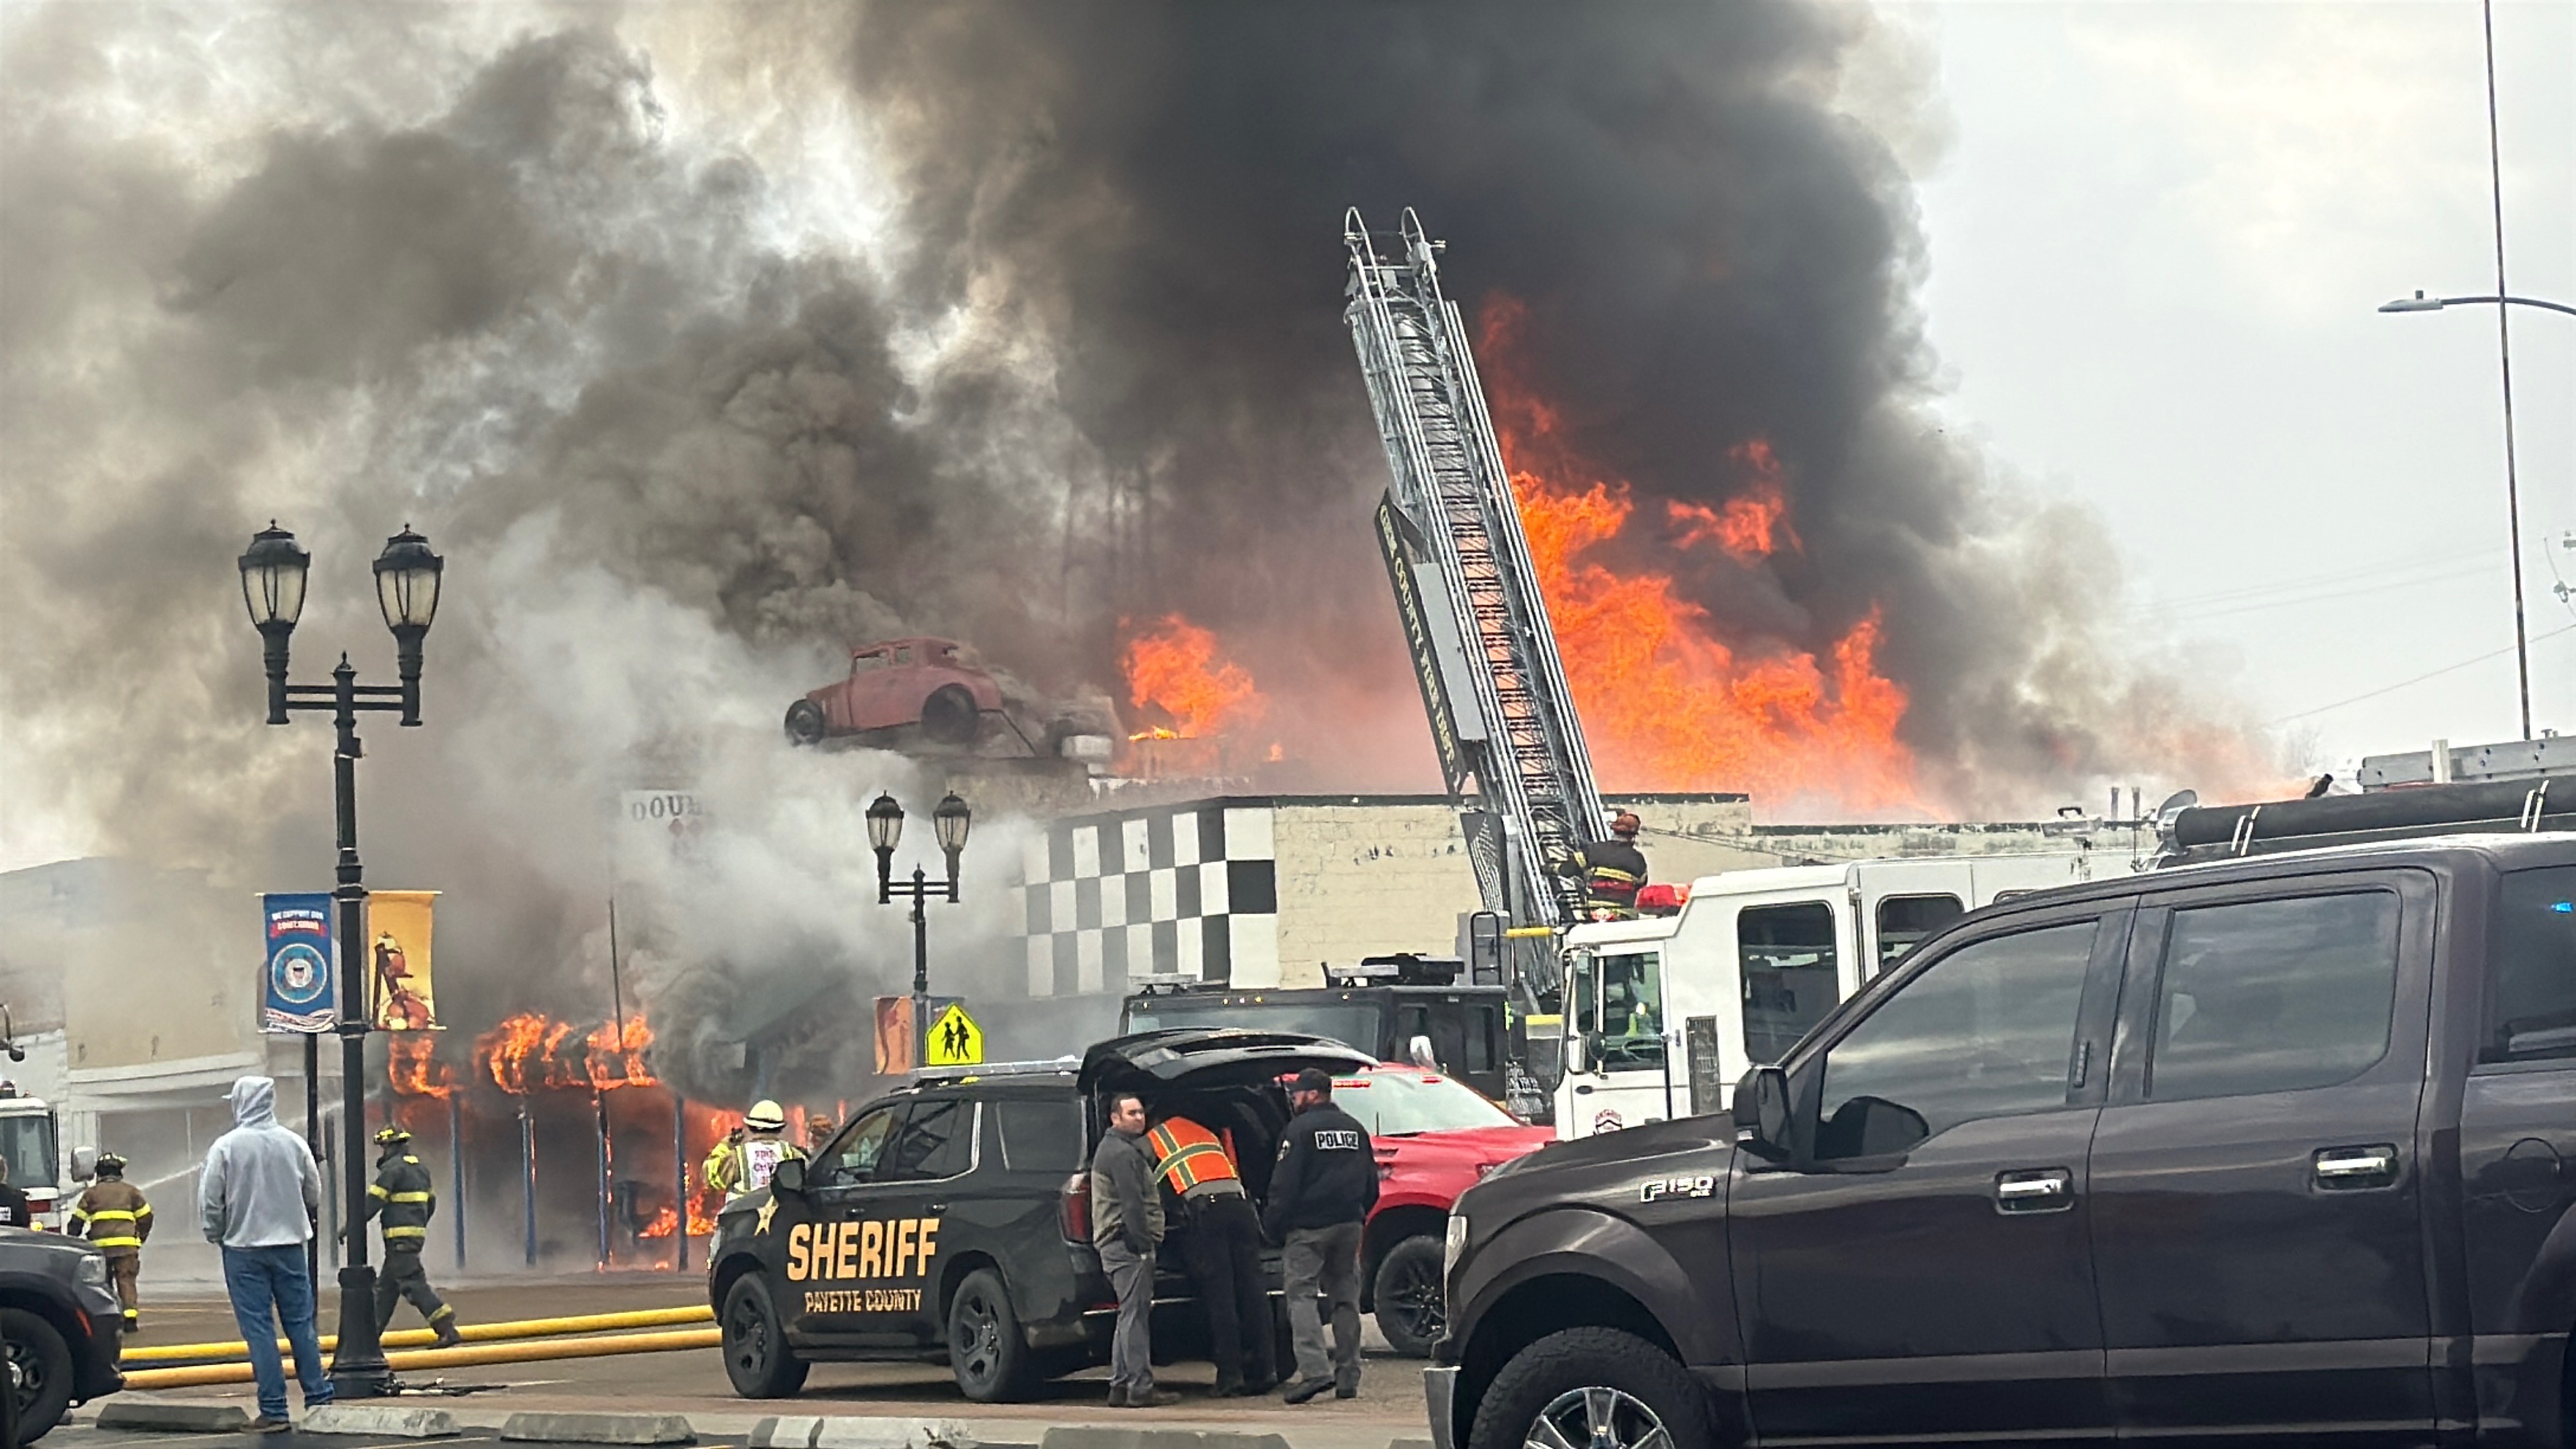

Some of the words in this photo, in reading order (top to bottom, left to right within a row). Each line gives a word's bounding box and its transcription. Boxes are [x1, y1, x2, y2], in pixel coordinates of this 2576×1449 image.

[1396, 557, 1423, 650] COUNTY
[1317, 1133, 1358, 1147] POLICE
[787, 1218, 940, 1281] SHERIFF
[804, 1290, 861, 1313] PAYETTE
[864, 1289, 921, 1311] COUNTY
